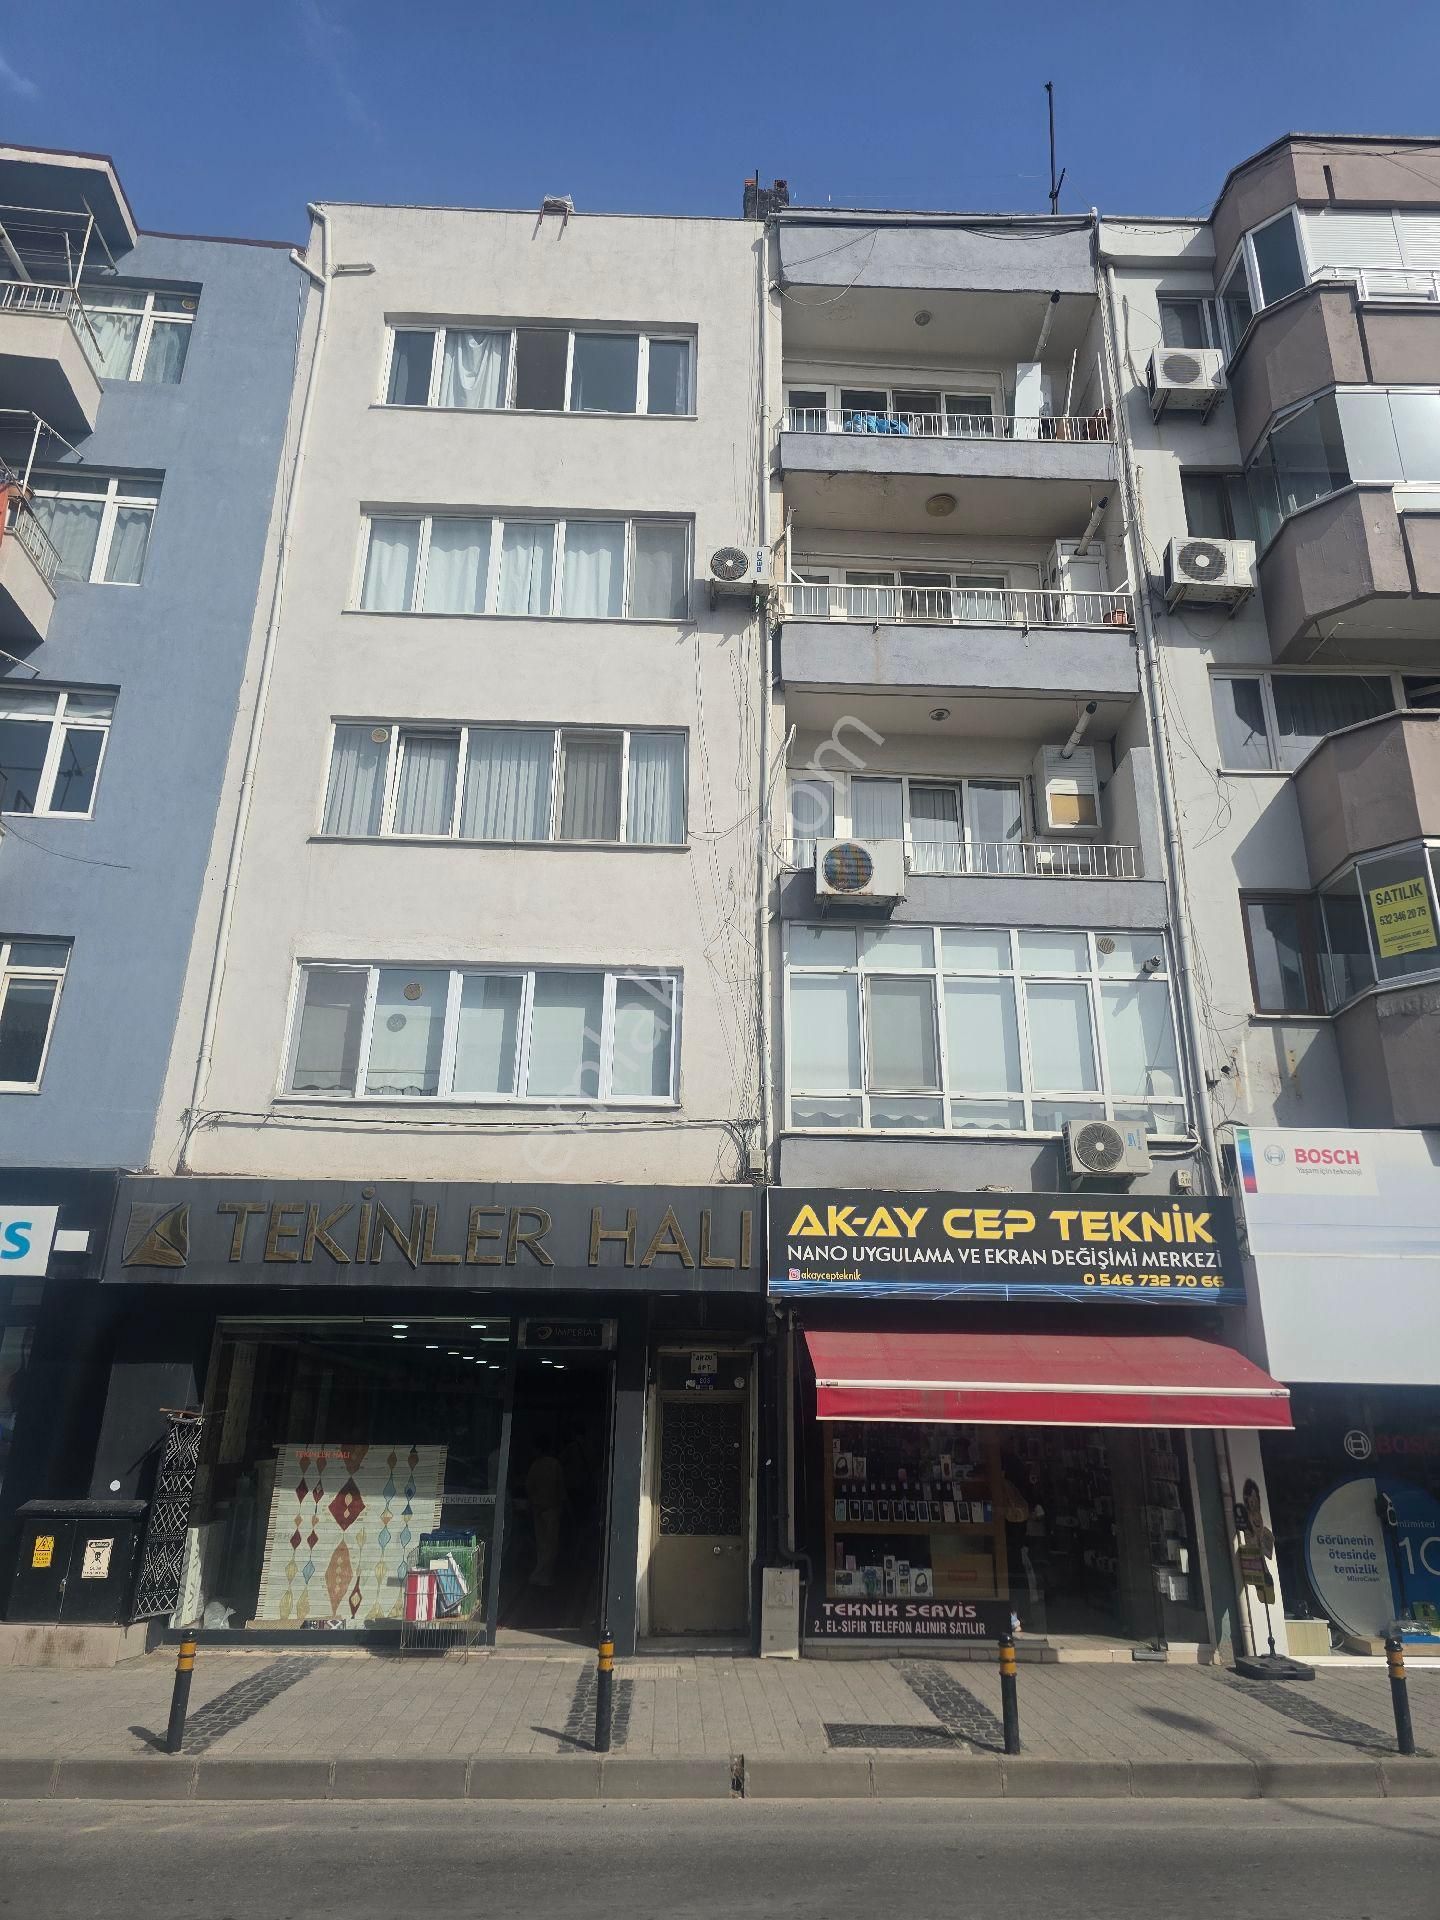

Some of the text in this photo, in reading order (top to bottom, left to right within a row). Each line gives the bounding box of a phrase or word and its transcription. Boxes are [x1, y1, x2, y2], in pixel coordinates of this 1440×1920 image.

[1375, 883, 1423, 905] SATILIK
[1379, 913, 1393, 926] 532
[1407, 908, 1417, 920] 20
[1417, 906, 1427, 917] 75
[1294, 1148, 1360, 1165] BOSCH
[1296, 1167, 1363, 1176] Yaşam için teknoloji
[217, 1186, 753, 1270] TEKİNLER HALI
[787, 1203, 1218, 1244] AK-AY CEP TEKNİK
[787, 1245, 1223, 1270] NANO UYGULAMA VE EKRAN DEĞİŞİMİ MERKEZİ
[801, 1268, 862, 1283] akaycepteknik
[1083, 1273, 1225, 1288] 0 546 732 70 66
[1397, 1519, 1436, 1529] nlimited
[1316, 1534, 1375, 1547] Görünenin
[1328, 1548, 1377, 1561] ötesinde
[1334, 1564, 1380, 1575] temizlik
[822, 1600, 977, 1618] TEKNİK SERVİS
[814, 1620, 986, 1635] 2. EL-SIFIR TELEFON ALINIR SATILIR
